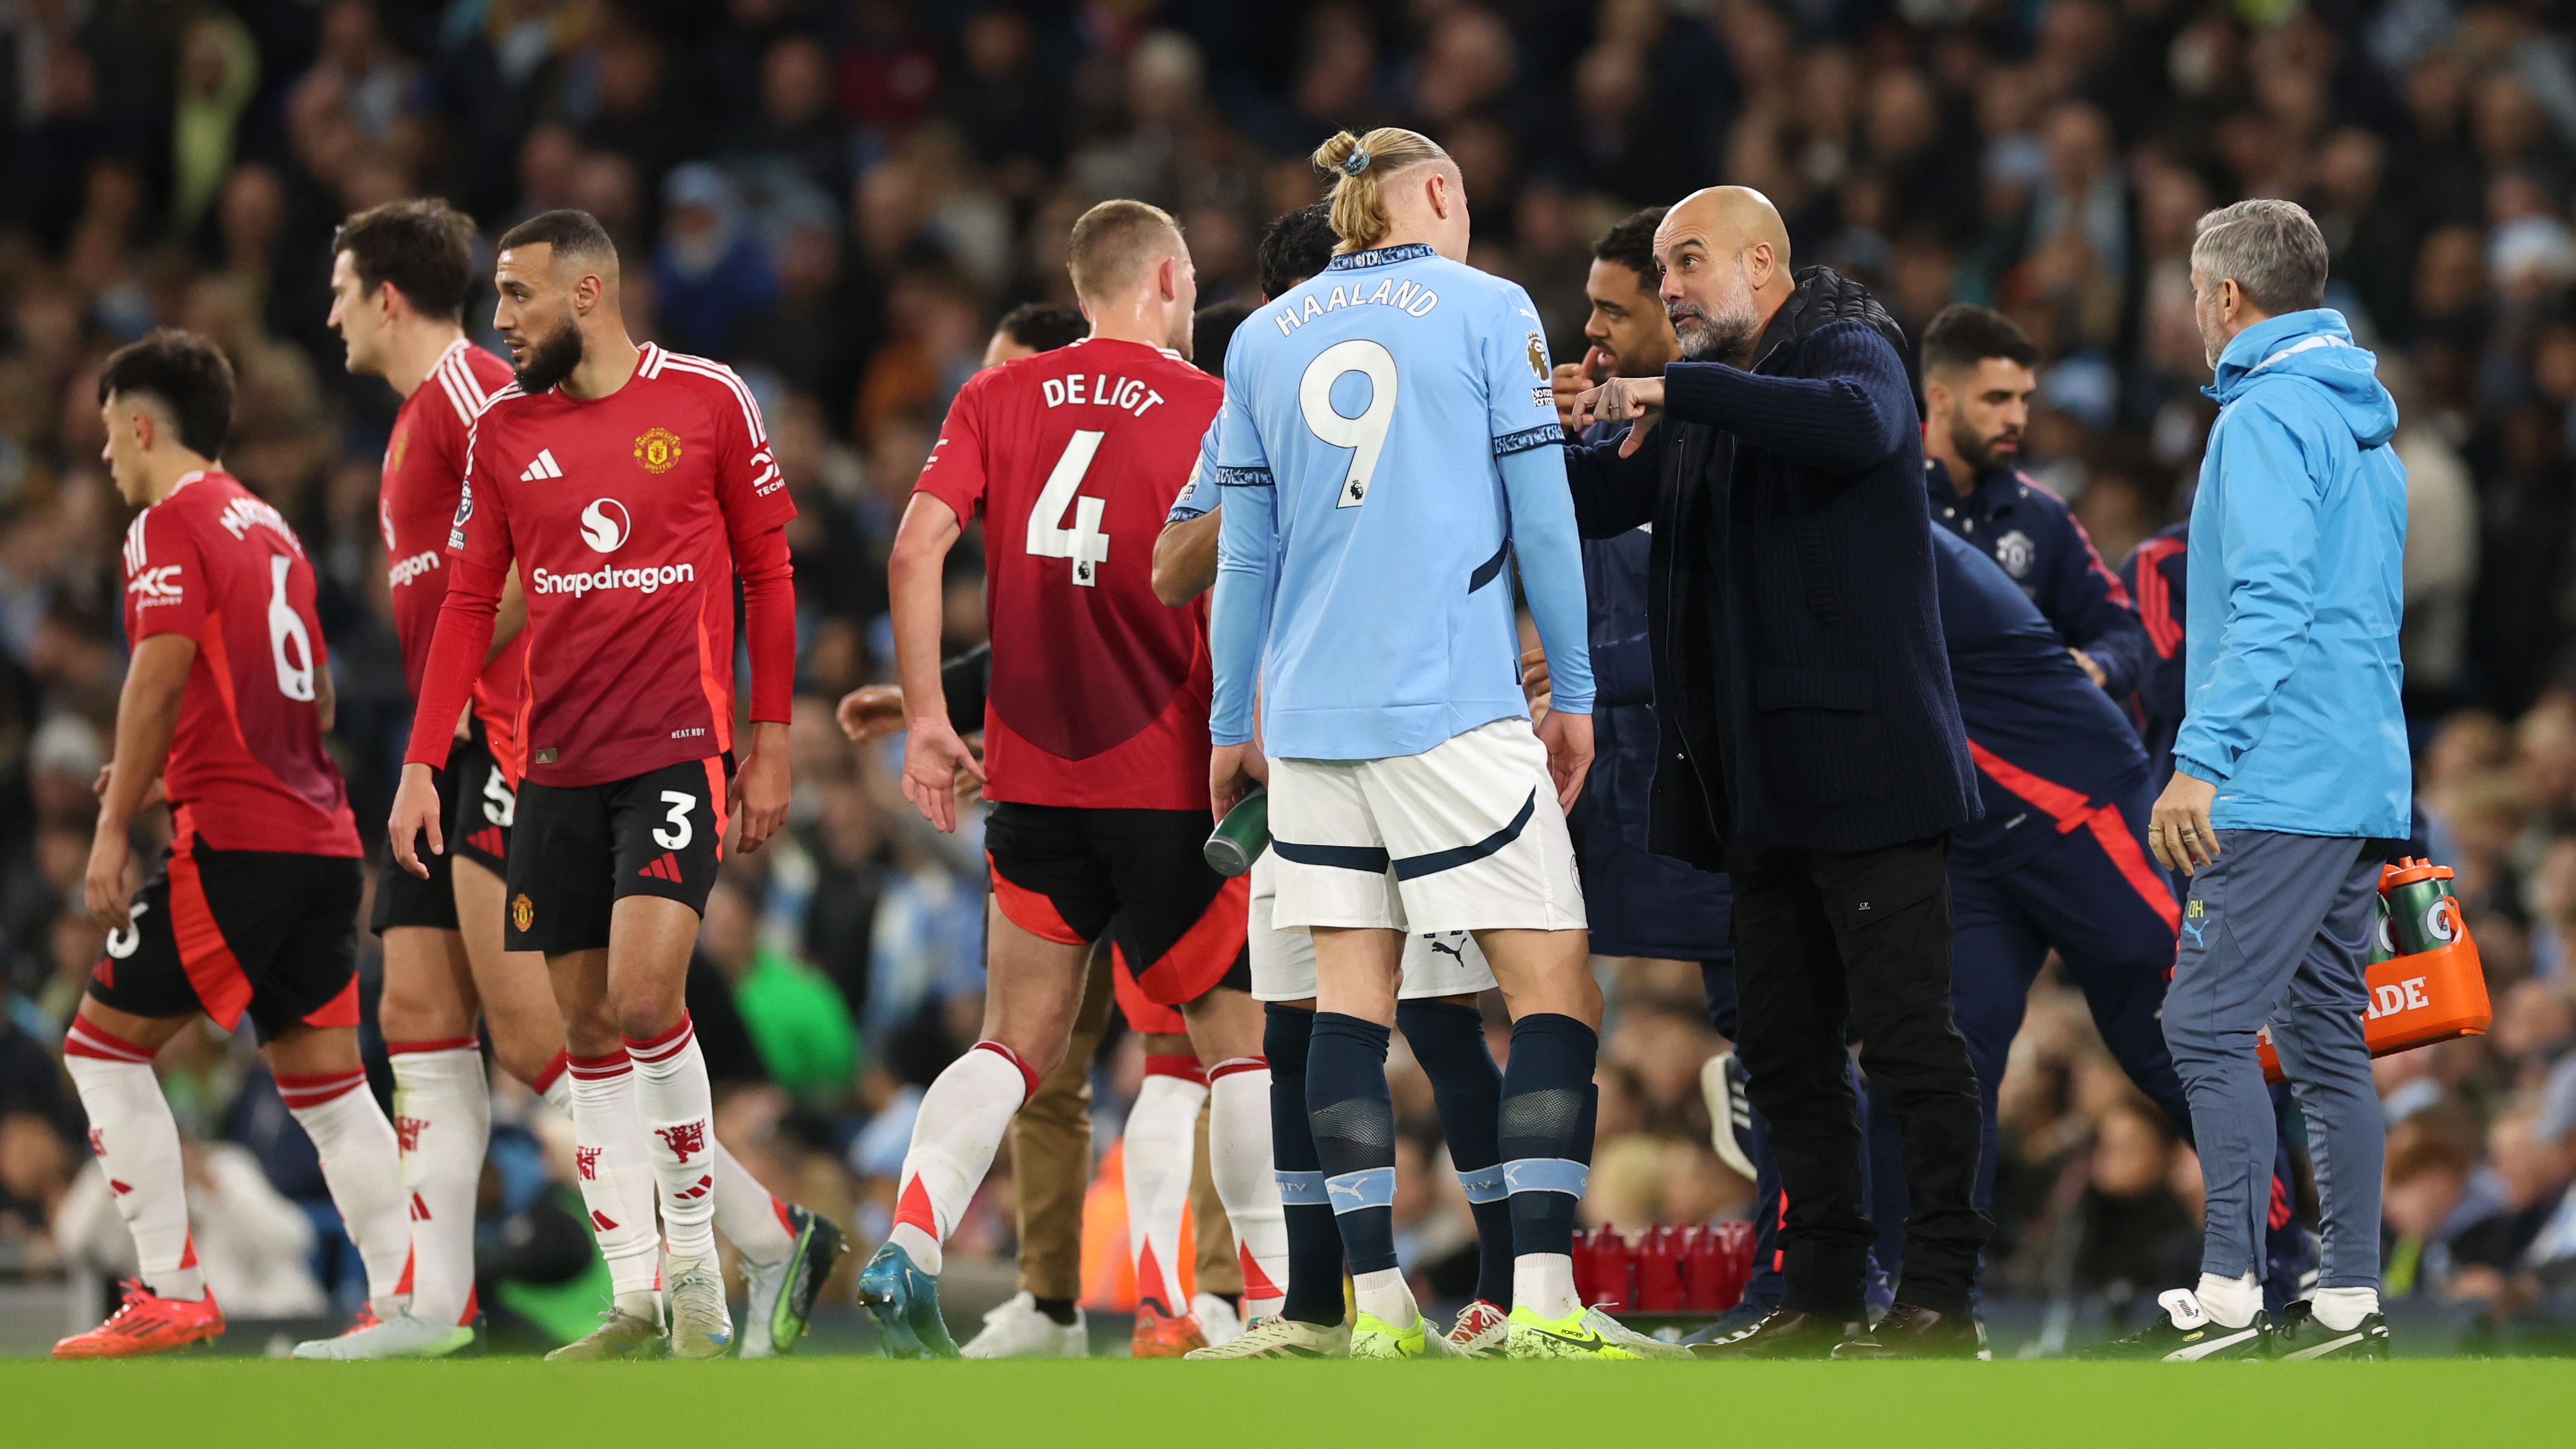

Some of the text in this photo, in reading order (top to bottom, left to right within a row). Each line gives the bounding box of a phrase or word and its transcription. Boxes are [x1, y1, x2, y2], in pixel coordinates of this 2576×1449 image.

[1356, 252, 1379, 266] CITY
[1274, 278, 1439, 337] HAALAND
[1042, 374, 1165, 417] DE LIGT
[1299, 339, 1398, 509] 9
[1026, 429, 1110, 587] 4
[533, 563, 694, 598] Snapdragon
[268, 555, 315, 701] 6
[671, 728, 705, 739] HEAT.RDY
[483, 764, 515, 827] 5
[652, 791, 697, 850] 3
[2177, 1299, 2194, 1316] PUMA
